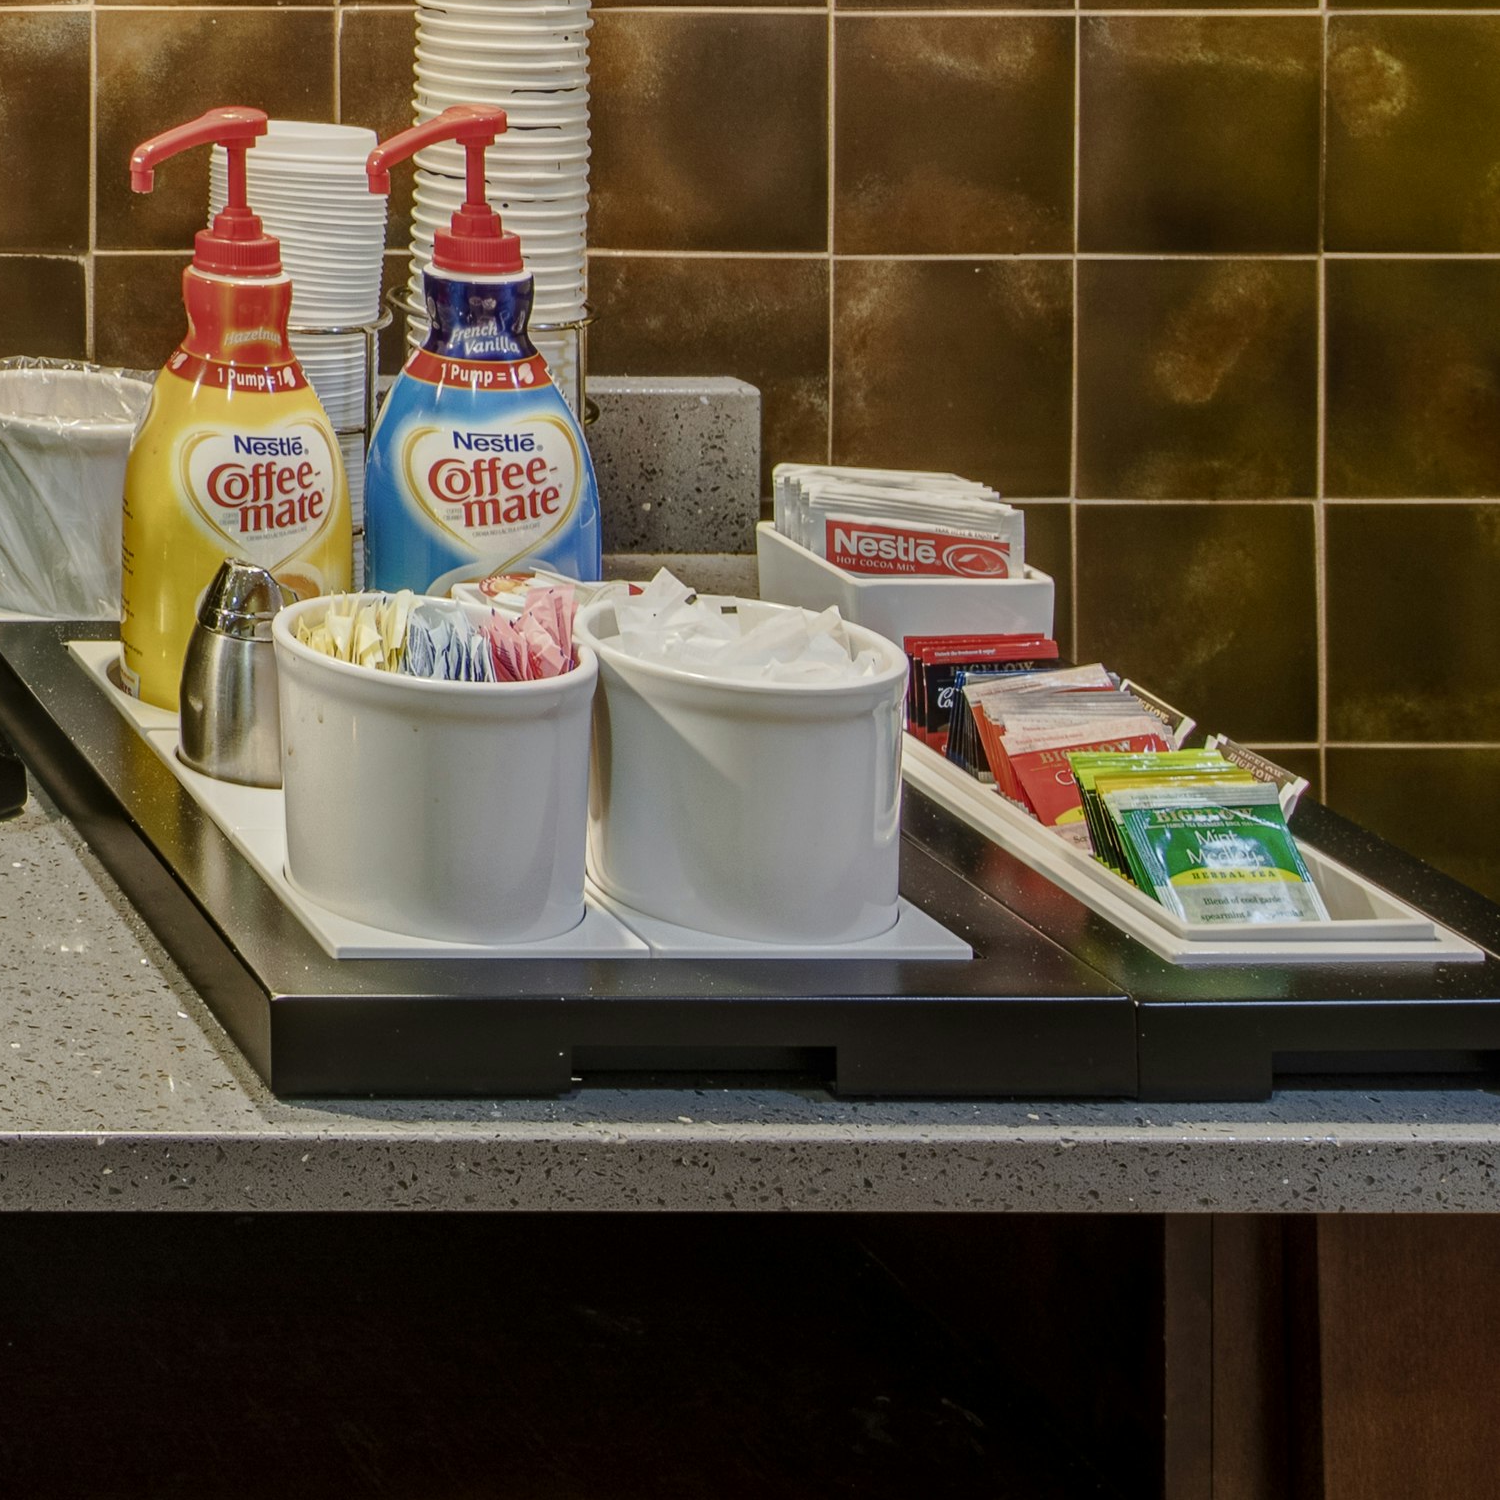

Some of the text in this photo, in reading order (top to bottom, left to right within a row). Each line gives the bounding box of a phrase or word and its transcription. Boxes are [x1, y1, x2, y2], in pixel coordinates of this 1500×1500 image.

[450, 320, 498, 343] French
[464, 336, 521, 356] Vanilla
[217, 367, 224, 383] 1
[228, 368, 267, 391] Pump
[440, 363, 447, 380] 1
[450, 363, 493, 387] Pump
[239, 489, 324, 532] mate
[462, 485, 560, 528] mate
[836, 555, 915, 573] HOT COCOA MIX
[1194, 828, 1238, 845] Mint
[1192, 870, 1276, 880] HERBAL TEA
[1203, 896, 1228, 906] Blend
